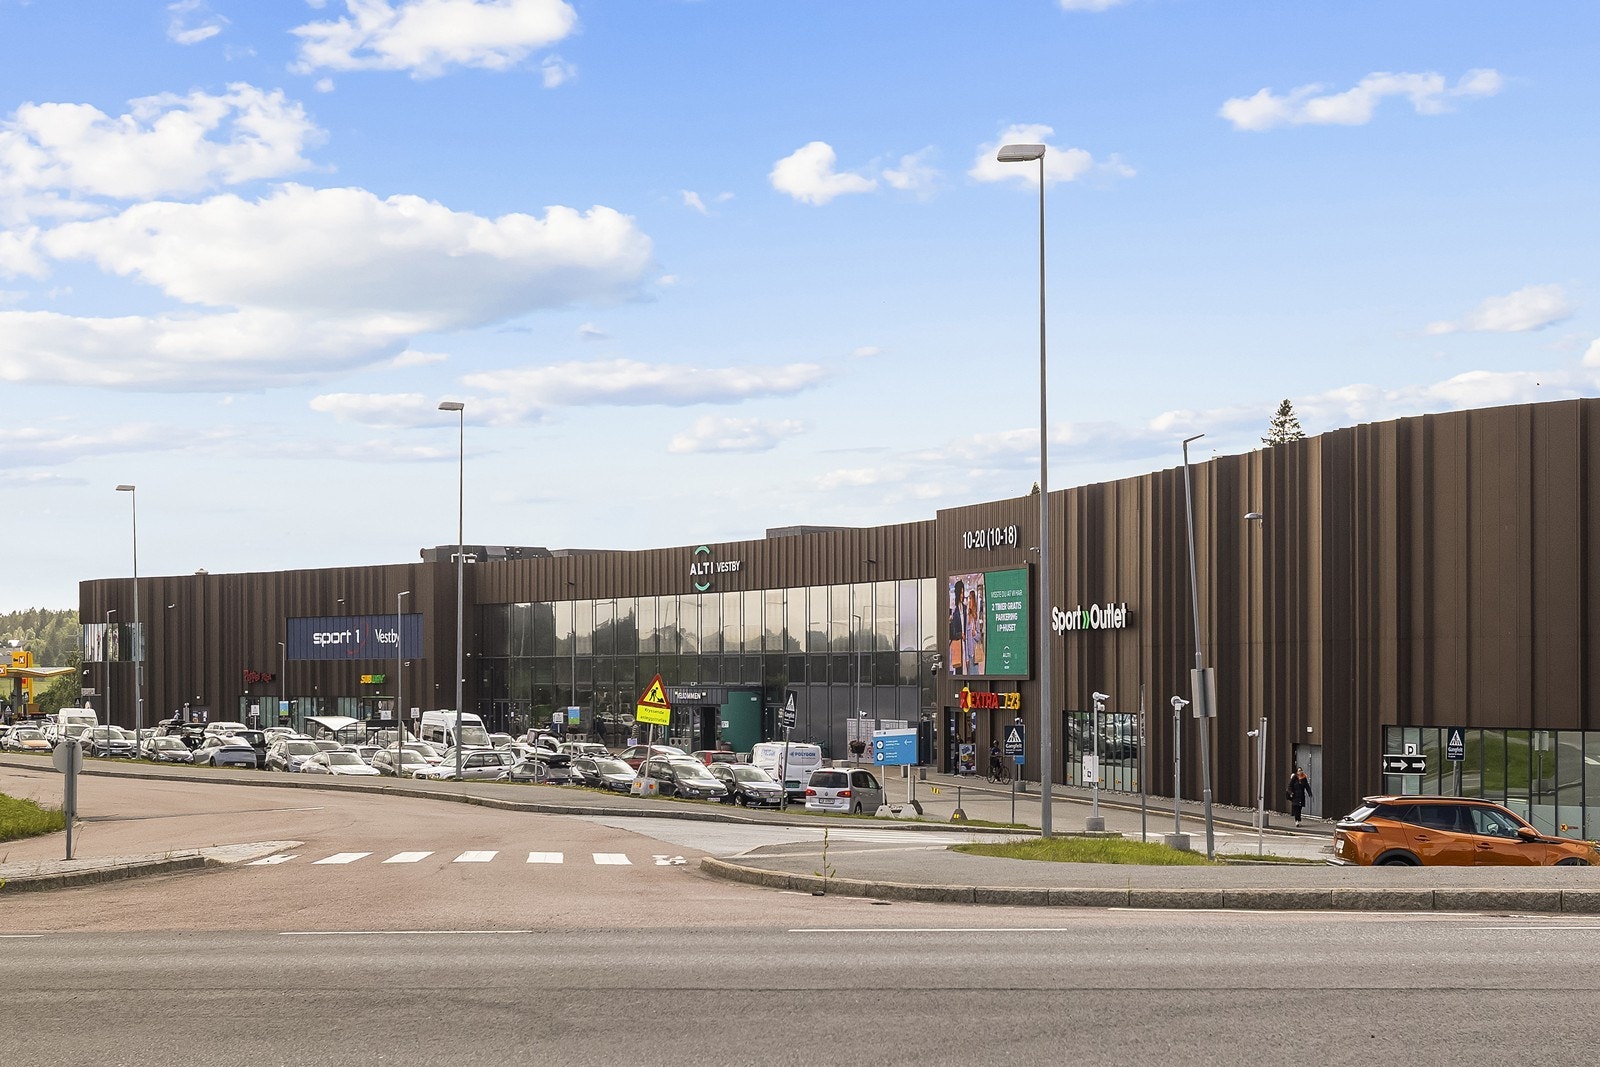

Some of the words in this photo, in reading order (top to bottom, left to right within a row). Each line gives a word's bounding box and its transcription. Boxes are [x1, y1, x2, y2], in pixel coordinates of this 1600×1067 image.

[963, 530, 985, 549] 10-20
[987, 525, 1017, 551] (10-18)
[690, 562, 713, 575] ALTI
[716, 560, 740, 572] VESTBY
[1007, 601, 1022, 610] GRATIS
[1052, 605, 1081, 636] Sport
[1090, 602, 1127, 629] Outlet
[313, 629, 352, 648] sport
[355, 629, 360, 643] 1
[375, 628, 399, 648] Vestby
[970, 691, 999, 709] EXTRA
[1003, 692, 1020, 710] 7-23
